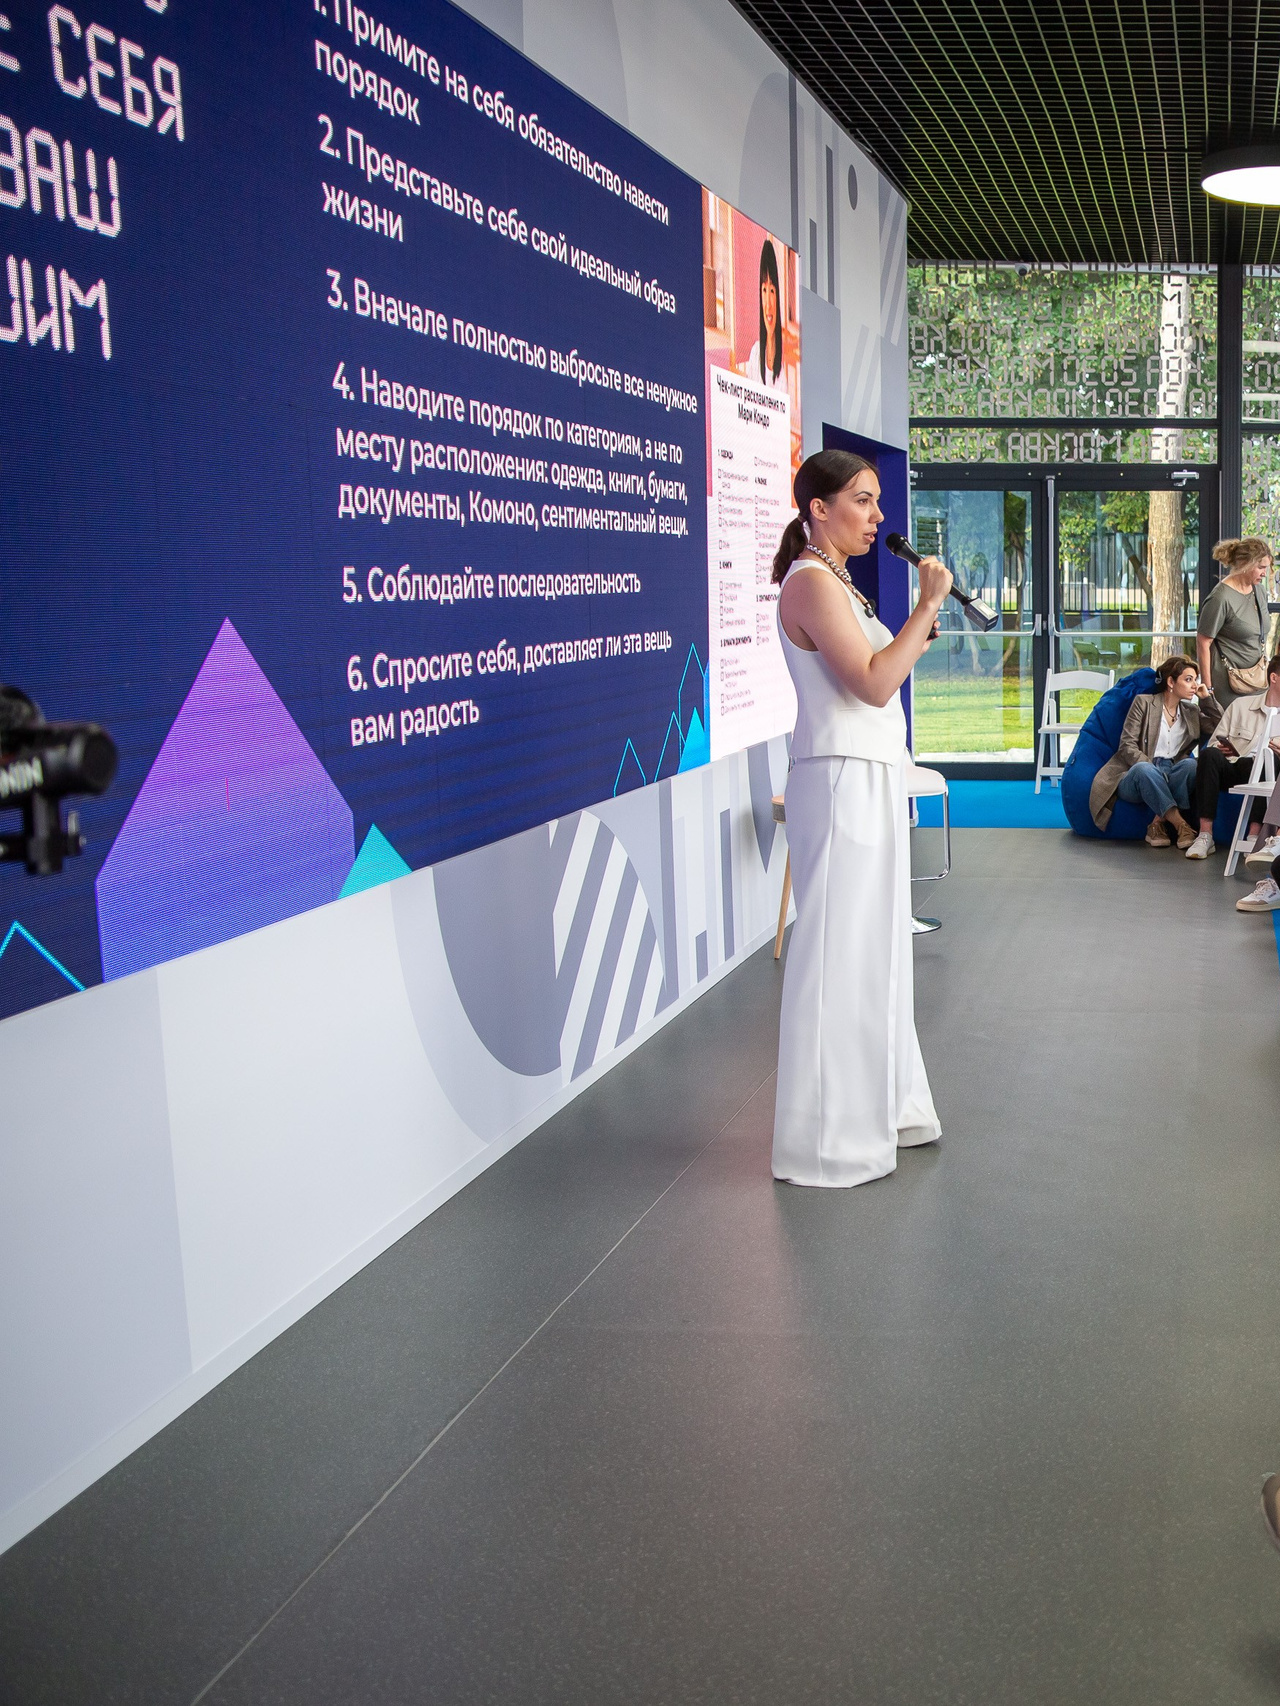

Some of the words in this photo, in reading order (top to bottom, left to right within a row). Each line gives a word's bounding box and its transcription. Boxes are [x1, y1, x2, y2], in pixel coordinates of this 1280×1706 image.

[47, 3, 186, 142] СЕБЯ
[314, 39, 421, 126] порядок
[334, 0, 441, 85] Примите
[445, 66, 469, 103] на
[472, 85, 515, 131] себя
[518, 113, 622, 196] обязательство
[623, 180, 670, 226] навести
[317, 113, 341, 159] 2.
[346, 126, 485, 225] Представьте
[487, 206, 529, 246] себе
[531, 227, 568, 265] свой
[570, 246, 643, 298] идеальный
[643, 279, 677, 315] образ
[321, 181, 405, 243] жизни
[325, 267, 349, 312] 3.
[354, 277, 449, 341] Вначале
[452, 317, 547, 371] полностью
[549, 348, 622, 392] выбросьте
[623, 373, 646, 399] все
[646, 380, 698, 415] ненужное
[331, 361, 356, 401] 4.
[360, 367, 466, 423] Наводите
[469, 399, 544, 440] порядок
[545, 416, 565, 442] по
[566, 421, 644, 463] категориям,
[644, 438, 653, 460] а
[653, 440, 669, 463] не
[669, 443, 684, 466] по
[716, 373, 743, 399] Чек-лист
[335, 426, 407, 474] месту
[410, 439, 550, 485] расположения:
[550, 462, 608, 497] одежда,
[608, 471, 648, 501] книги,
[647, 470, 689, 506] бумаги,
[337, 483, 466, 528] документы,
[469, 490, 541, 533] Комоно,
[541, 504, 658, 534] сентиментальный
[658, 514, 690, 539] вещи.
[342, 566, 364, 604] 5.
[367, 563, 495, 606] Соблюдайте
[498, 572, 642, 602] последовательность
[347, 654, 369, 693] 6.
[372, 652, 474, 695] Спросите
[476, 638, 522, 676] себя,
[523, 637, 605, 675] доставляет
[604, 635, 623, 659] ли
[623, 632, 643, 656] эта
[643, 630, 674, 654] вещь
[350, 712, 396, 748] вам
[400, 699, 481, 747] радость
